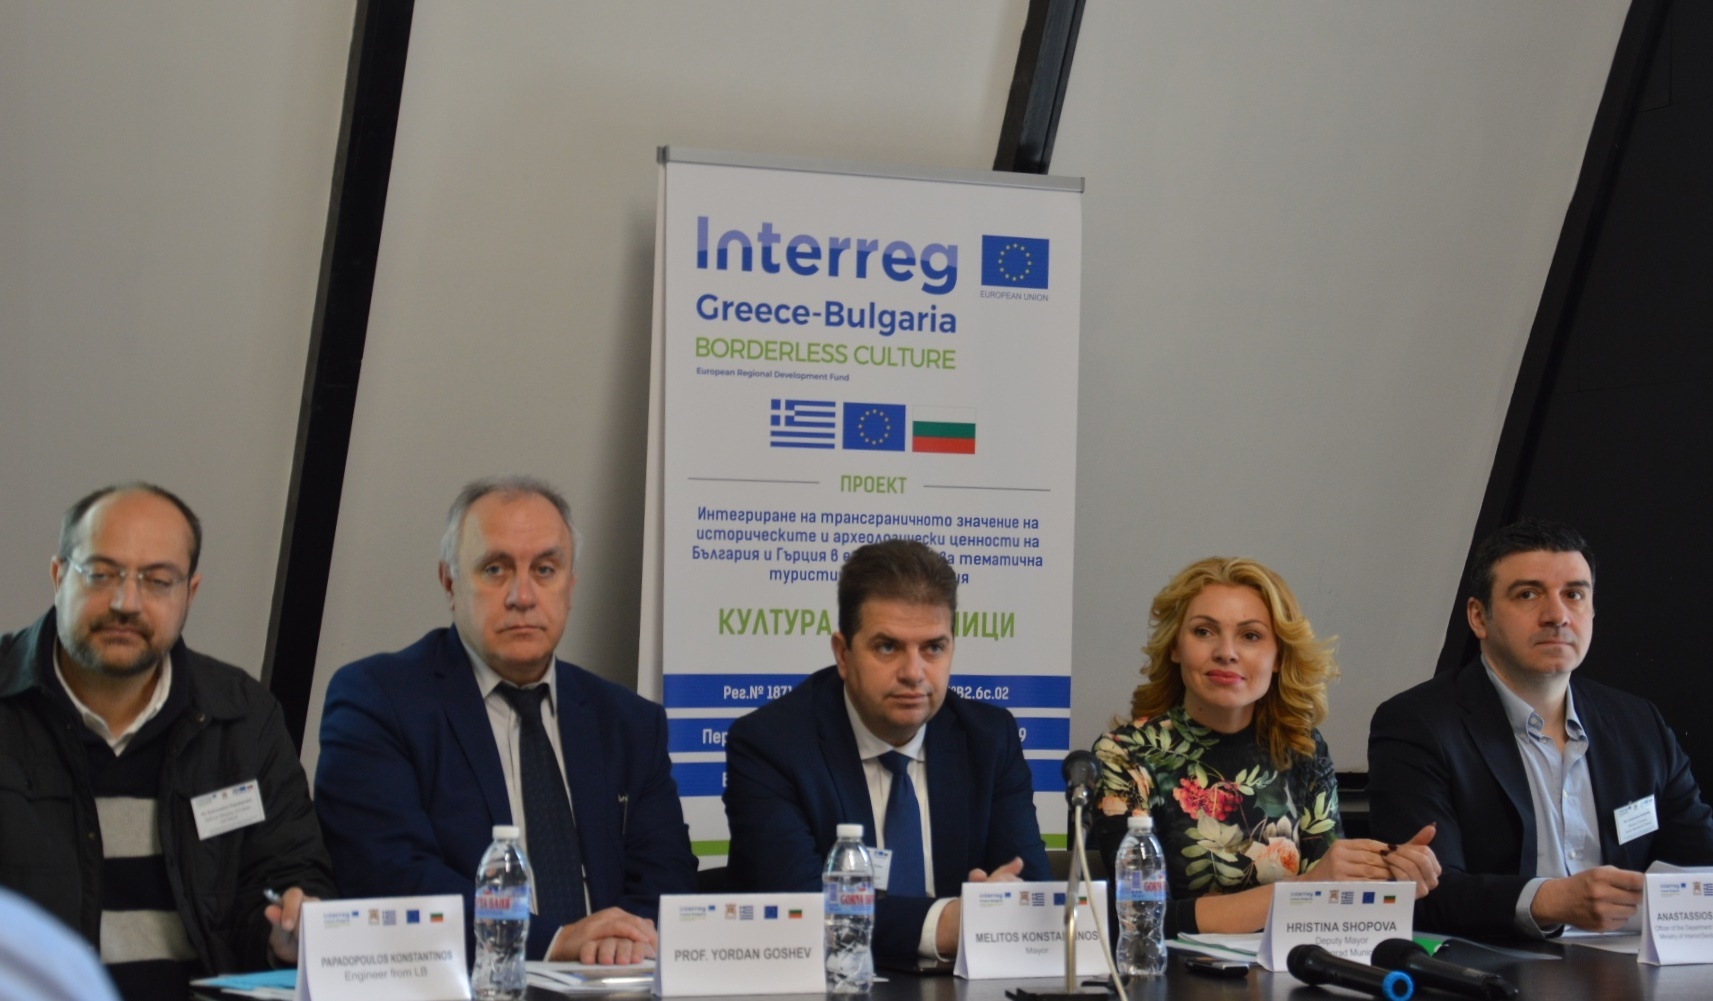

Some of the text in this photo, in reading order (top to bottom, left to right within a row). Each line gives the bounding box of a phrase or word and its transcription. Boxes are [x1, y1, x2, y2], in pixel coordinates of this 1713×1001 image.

[696, 215, 959, 296] Interreg
[979, 290, 1049, 302] EUROPEAN UNION
[696, 293, 957, 336] Greece-Bulgaria
[695, 337, 957, 371] BORDERLESS CULTURE
[696, 367, 850, 382] European Regional Development Fund
[840, 475, 908, 495] ПРОЕКТ
[697, 506, 1039, 530] Интегриране на трансграничното значение на
[696, 529, 817, 544] историческите
[820, 532, 829, 543] и
[950, 534, 1020, 549] ценности
[1023, 536, 1040, 549] на
[692, 546, 760, 563] България
[764, 550, 772, 561] и
[776, 547, 827, 564] Гърция
[830, 548, 839, 562] в
[959, 553, 1043, 567] тематична
[718, 608, 832, 636] КУЛТУРА
[1286, 921, 1397, 933] HRISTINA SHOPOVA
[975, 932, 1019, 943] MELITOS
[1315, 935, 1369, 947] Deputy Mayor
[321, 949, 453, 968] PAPADOPOULOS KONSTANTINOS
[674, 947, 812, 961] PROF. YORDAN GOSHEV
[1025, 947, 1049, 956] Mayor
[344, 969, 388, 984] Engineer
[390, 967, 412, 979] from
